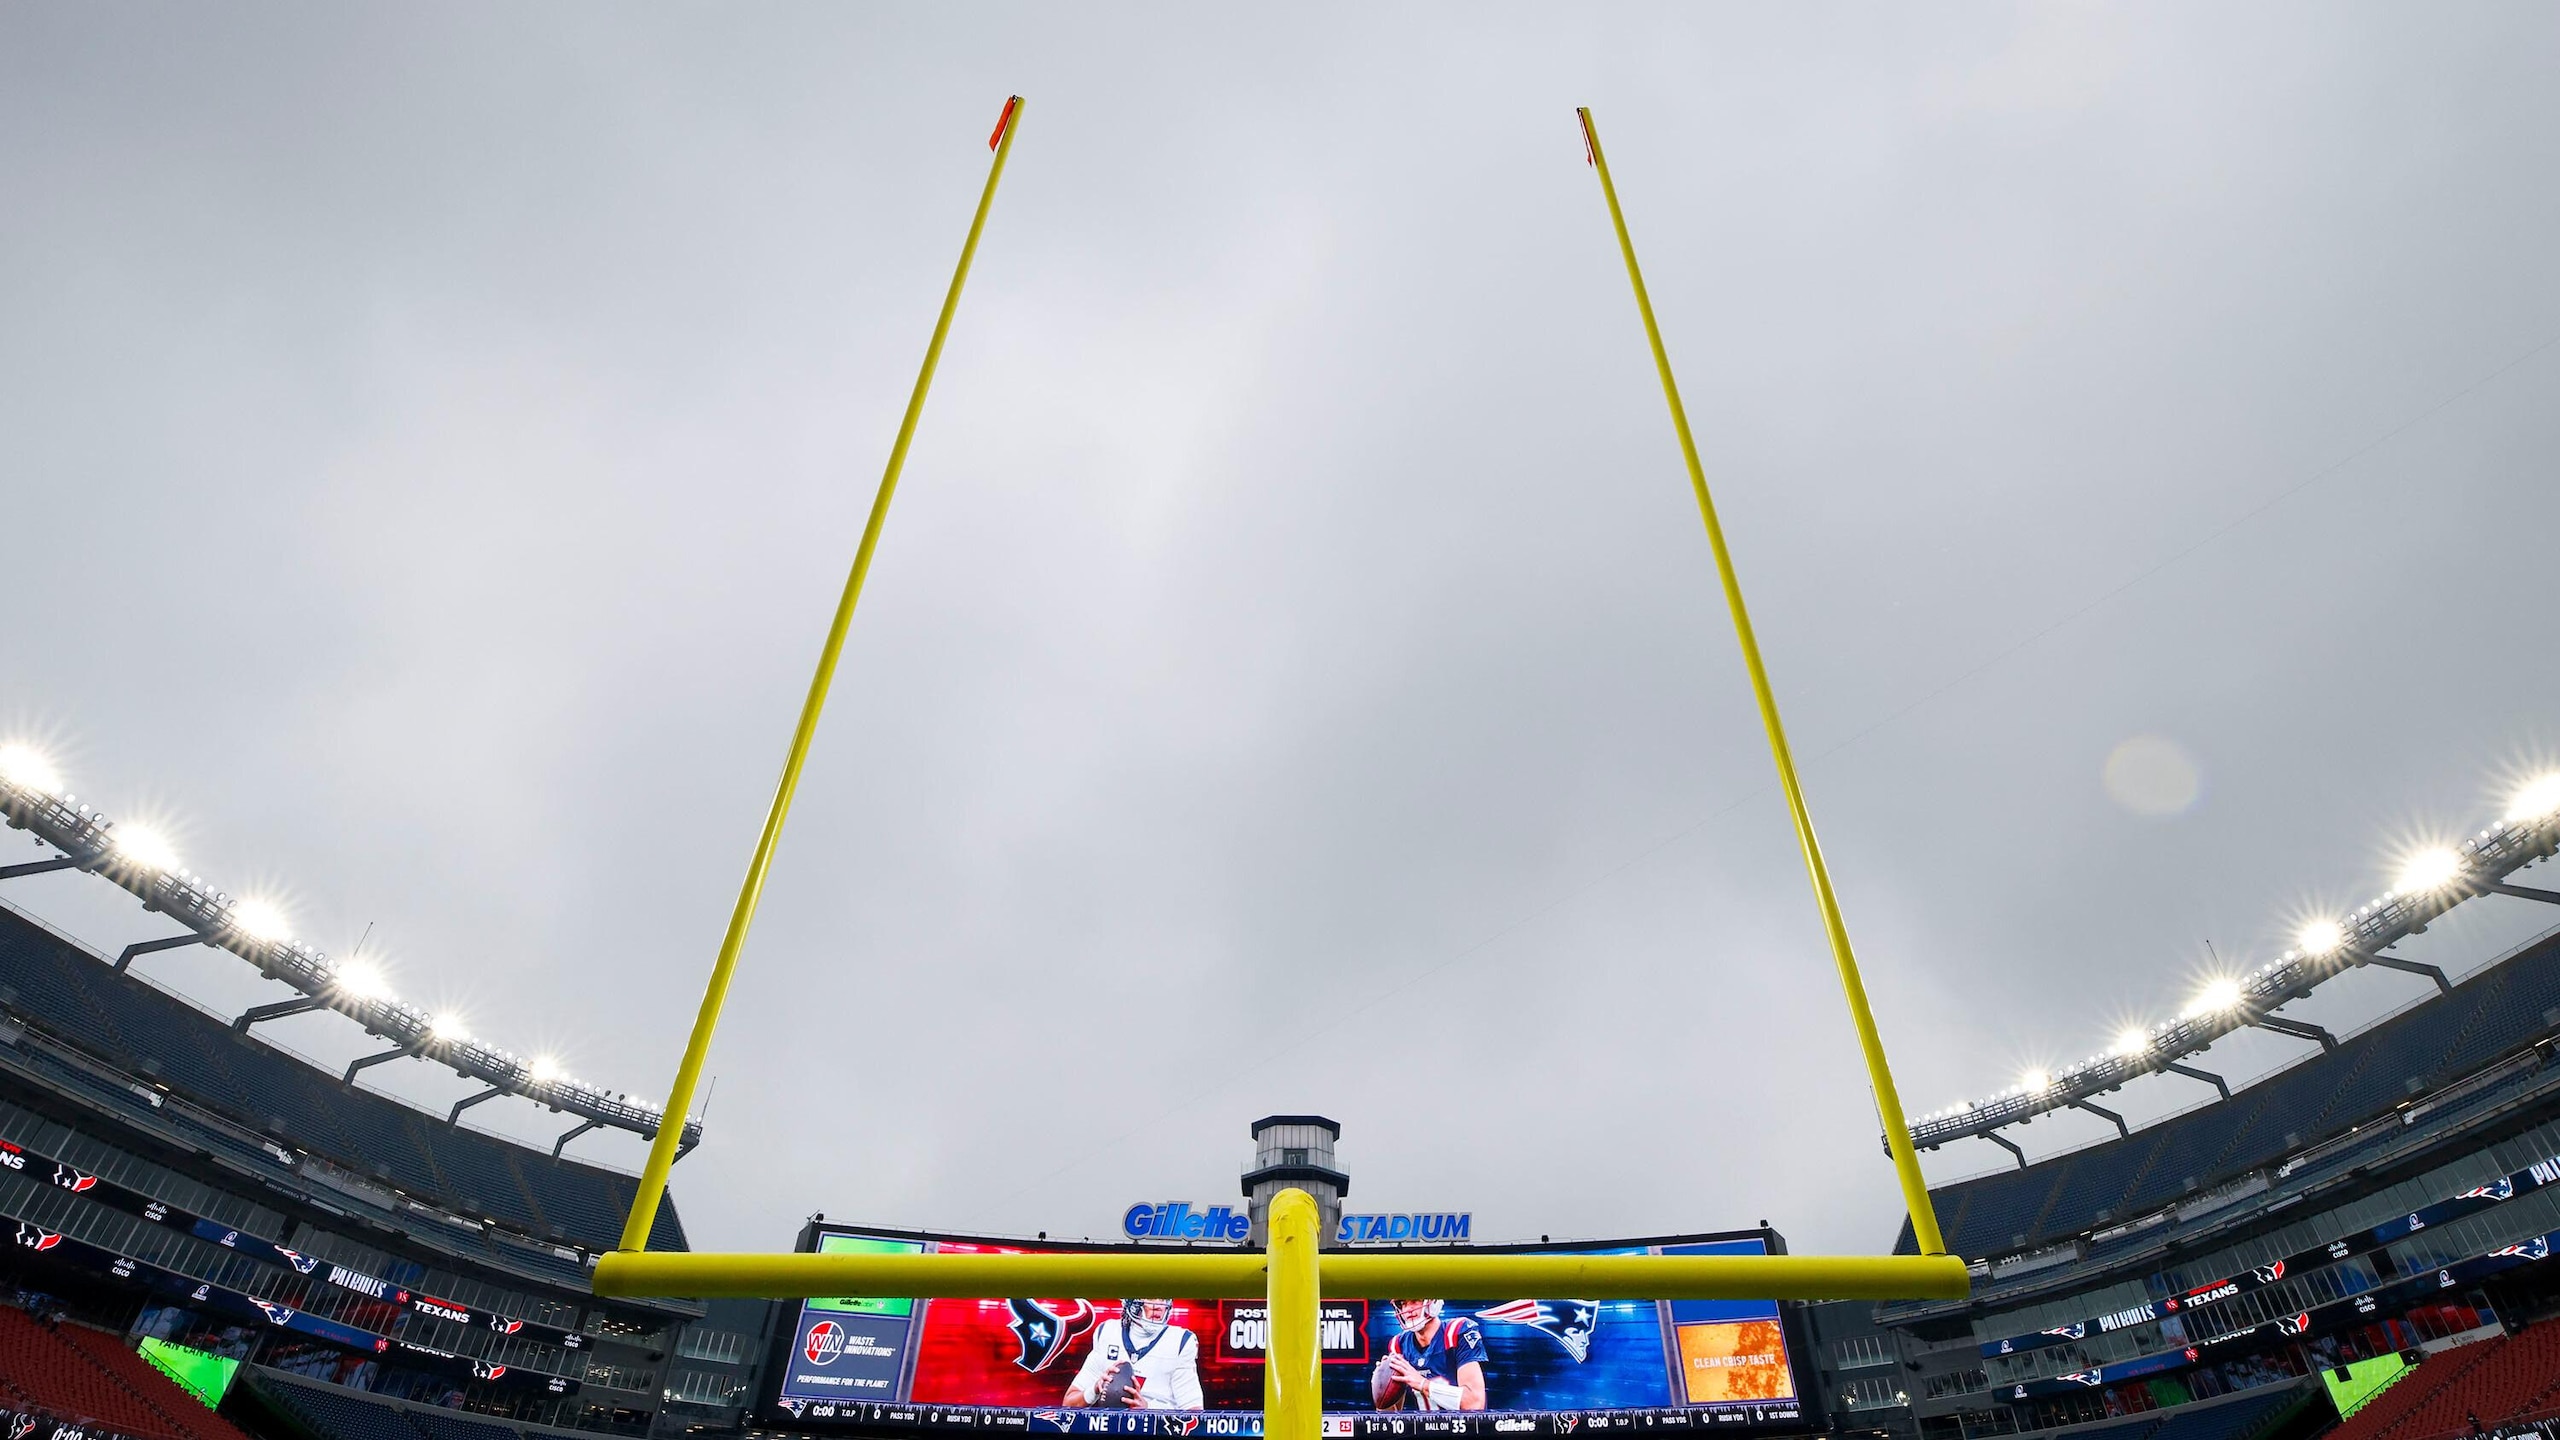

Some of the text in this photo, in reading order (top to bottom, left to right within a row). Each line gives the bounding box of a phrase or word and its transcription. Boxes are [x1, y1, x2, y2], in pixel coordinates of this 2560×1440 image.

[1124, 1202, 1250, 1240] Gillette
[1338, 1214, 1471, 1240] STADIUM
[2184, 1284, 2239, 1307] TEXANS
[415, 1301, 470, 1323] TEXANS
[1325, 1309, 1352, 1318] NFL
[849, 1335, 876, 1346] WASTE
[1694, 1354, 1775, 1368] CLEAN CRISP TASTE
[796, 1375, 889, 1388] PERFORMANCE FOR THE PLANET
[812, 1405, 835, 1417] 0:00
[873, 1409, 881, 1419] 0
[890, 1412, 903, 1420] PASS
[931, 1412, 938, 1422] 0
[961, 1415, 972, 1423] YDS
[984, 1414, 992, 1425] 0
[997, 1417, 1005, 1425] 1ST
[1006, 1417, 1025, 1425] DOWNS
[1588, 1416, 1608, 1428] 0:00
[1646, 1416, 1653, 1426] 0
[1662, 1417, 1676, 1425] PASS
[1676, 1416, 1687, 1424] YDS
[1702, 1413, 1710, 1423] 0
[1718, 1414, 1733, 1422] RUSH
[1733, 1413, 1744, 1421] YDS
[1757, 1411, 1764, 1421] 0
[1769, 1412, 1778, 1420] 1ST
[1779, 1411, 1799, 1419] DOWNS
[1089, 1416, 1136, 1431] NE 0
[1207, 1419, 1260, 1434] HOU 0
[1340, 1422, 1350, 1431] 25
[1382, 1423, 1388, 1431] &
[1391, 1420, 1405, 1434] 10
[1425, 1423, 1439, 1431] BALL
[1440, 1423, 1449, 1431] ON
[1452, 1420, 1466, 1434] 35
[1495, 1419, 1536, 1432] Gillette
